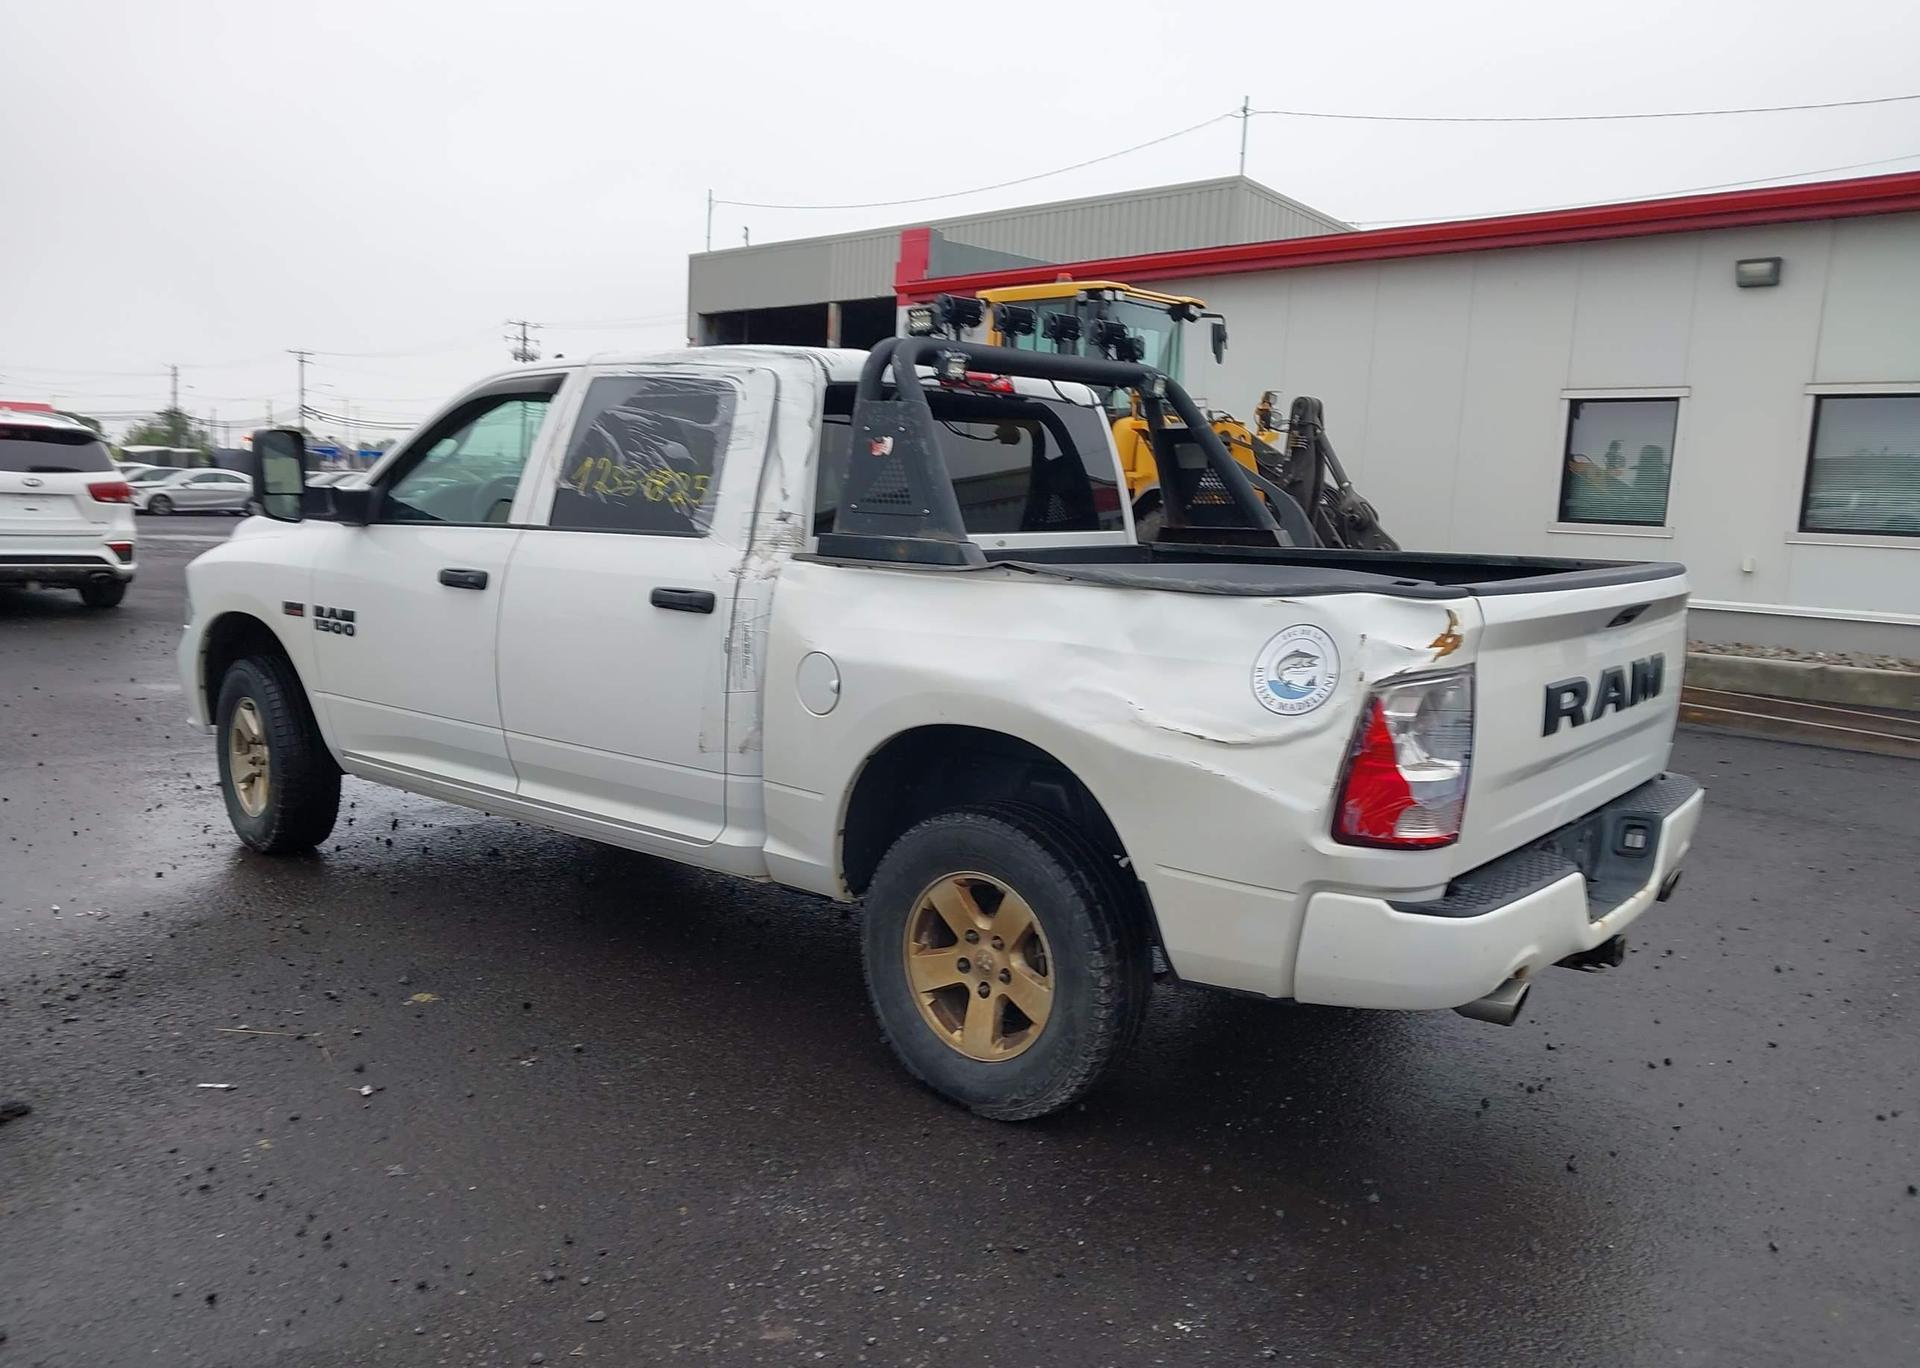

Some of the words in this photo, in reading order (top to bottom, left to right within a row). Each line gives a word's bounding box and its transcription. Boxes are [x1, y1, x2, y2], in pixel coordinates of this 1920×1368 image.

[314, 605, 355, 622] RAM
[314, 619, 355, 636] 1500
[1540, 652, 1666, 737] RAM
